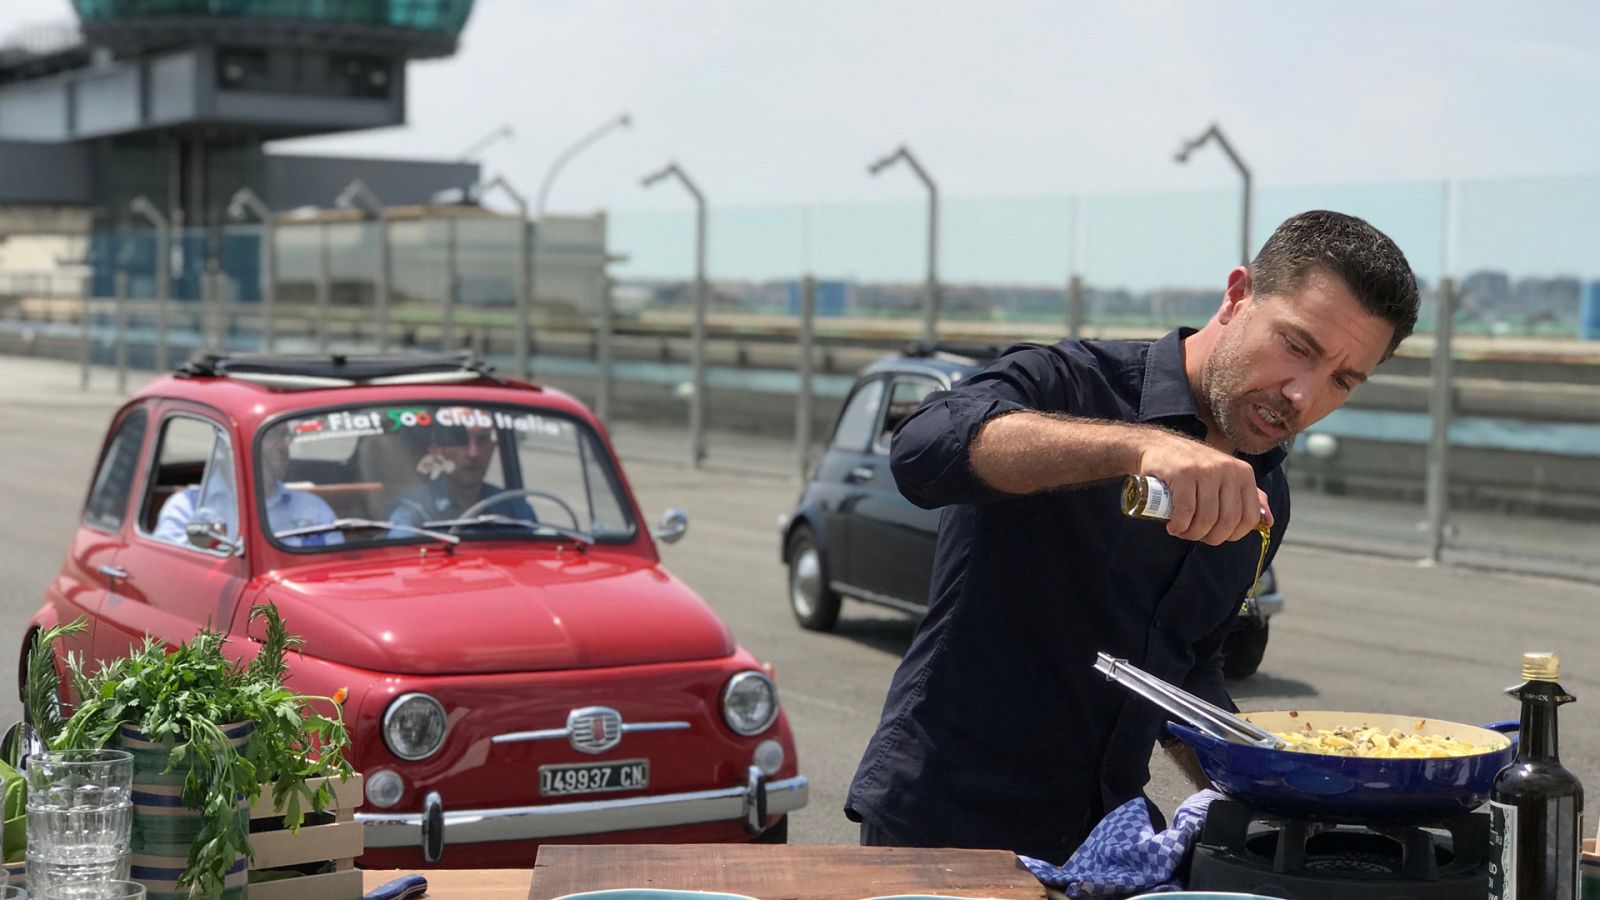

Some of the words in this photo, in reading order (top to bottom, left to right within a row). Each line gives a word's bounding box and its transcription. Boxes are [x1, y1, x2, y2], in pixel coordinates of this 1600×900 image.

[328, 411, 382, 431] Fiat
[386, 407, 431, 431] 500
[435, 406, 493, 429] Club
[494, 411, 561, 435] Italia
[543, 767, 612, 792] 149937
[620, 765, 643, 787] CN
